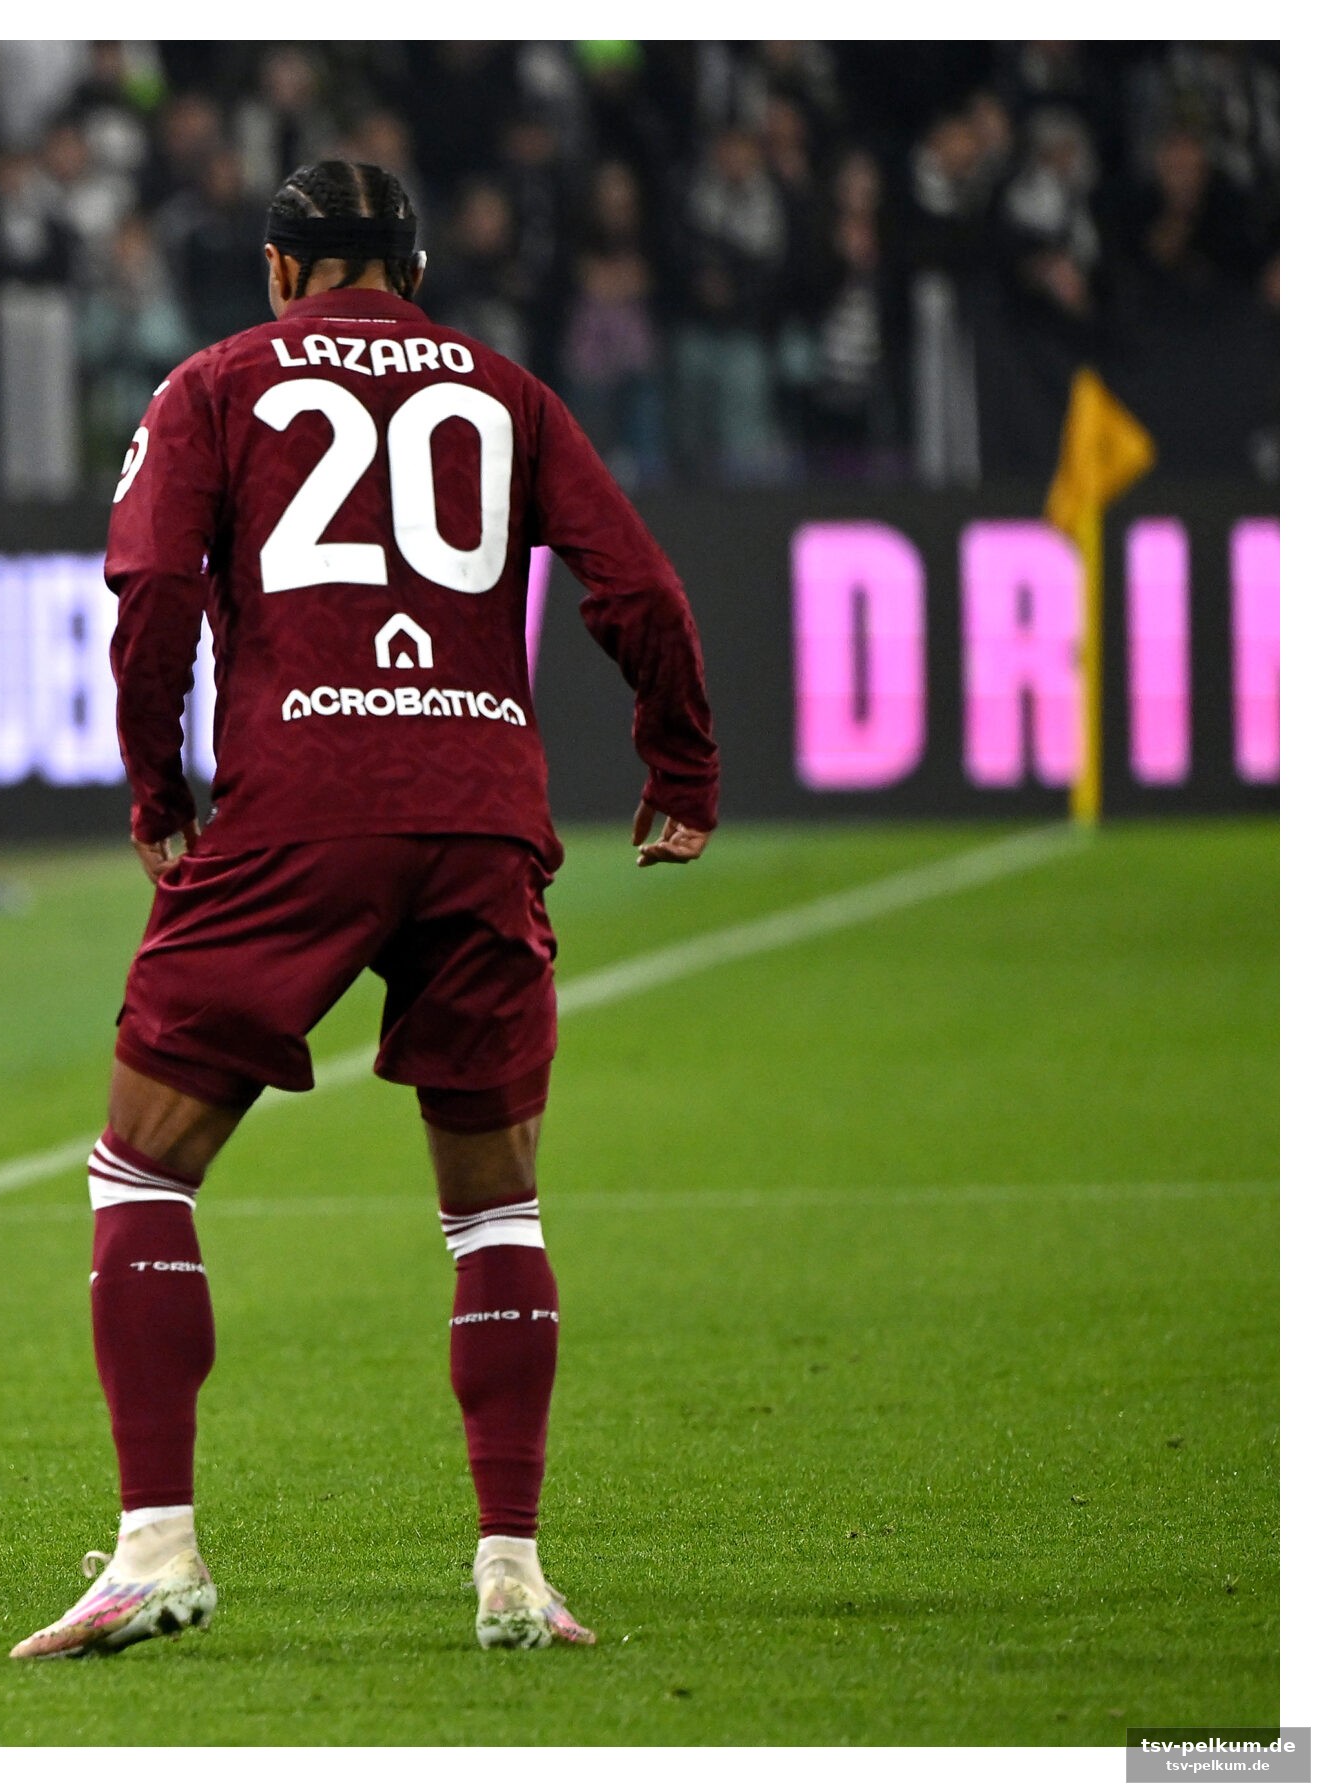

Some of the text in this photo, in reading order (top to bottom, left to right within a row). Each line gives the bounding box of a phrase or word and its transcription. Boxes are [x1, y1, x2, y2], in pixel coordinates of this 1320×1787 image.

[271, 334, 475, 376] LAZARO
[252, 378, 513, 594] 20
[282, 686, 526, 726] ACROBATICA
